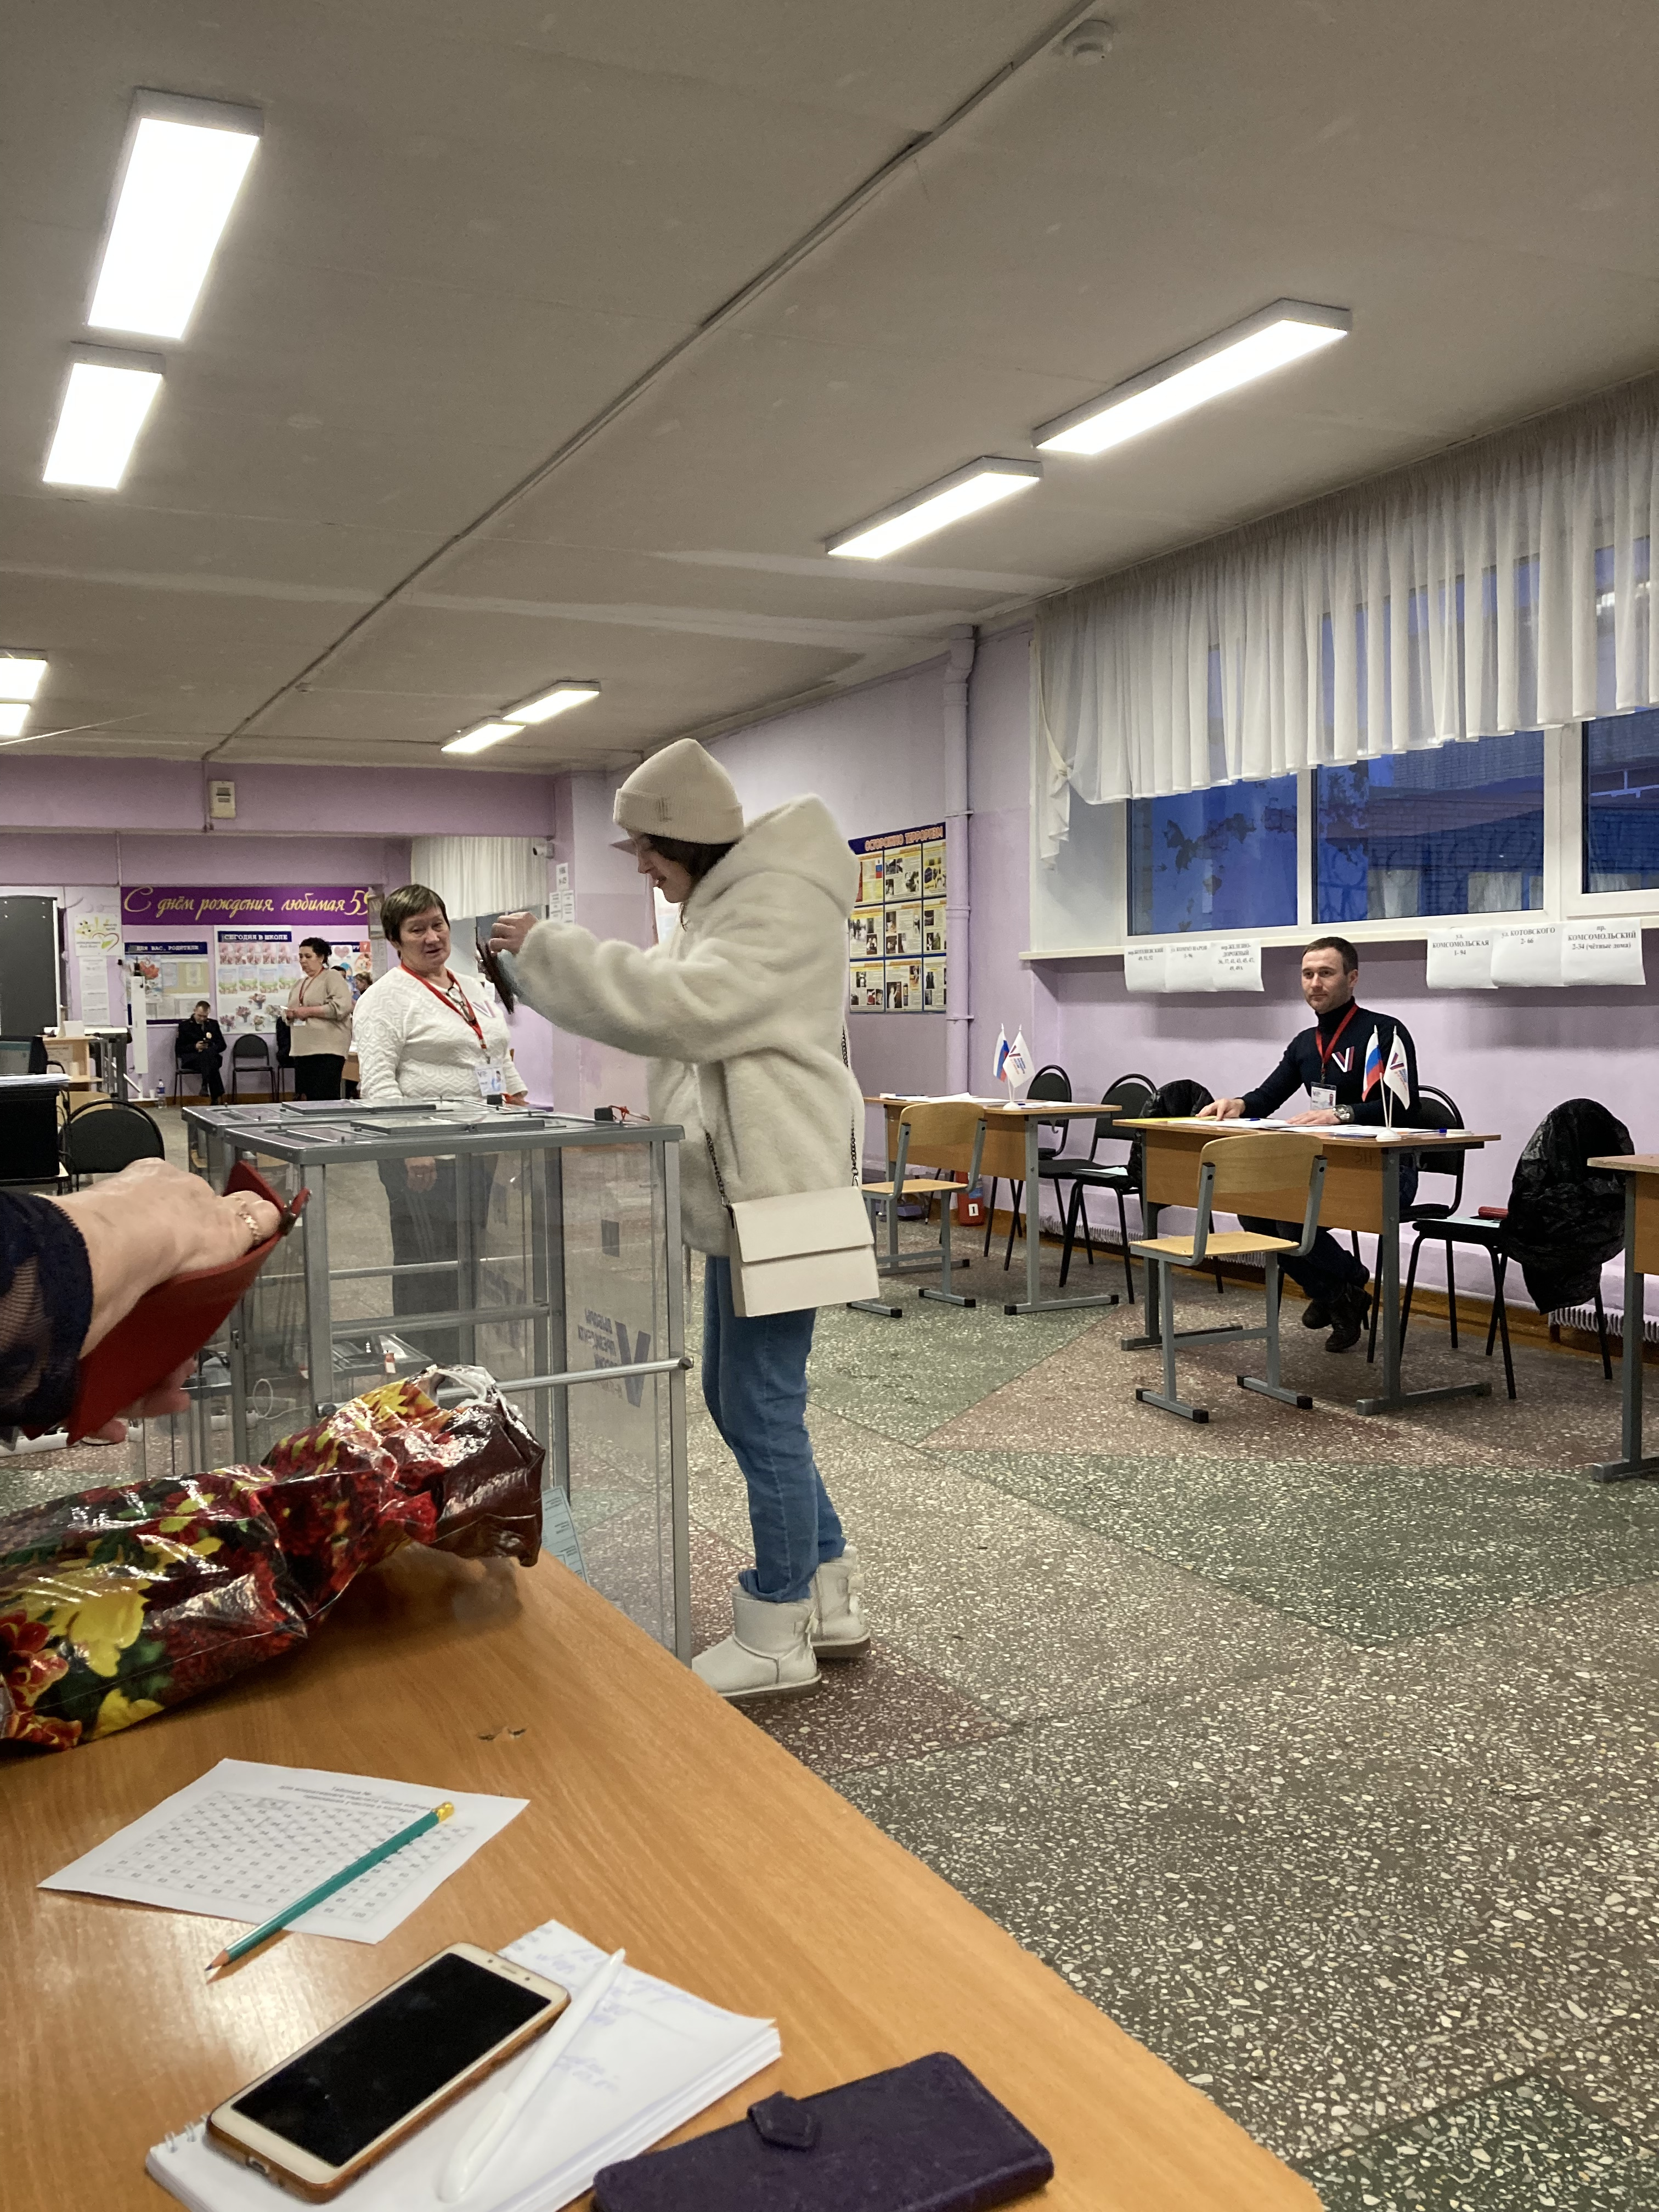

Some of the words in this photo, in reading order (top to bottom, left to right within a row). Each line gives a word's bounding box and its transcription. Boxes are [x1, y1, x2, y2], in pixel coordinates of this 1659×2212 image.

[124, 886, 154, 912] С
[155, 895, 195, 918] днём
[281, 892, 346, 912] любимая
[1510, 927, 1556, 936] КОТОВСКОГО
[1568, 930, 1637, 941] КОМСОМОЛЬСКИЙ
[1432, 940, 1489, 949] КОМСОМОЛЬСКАЯ
